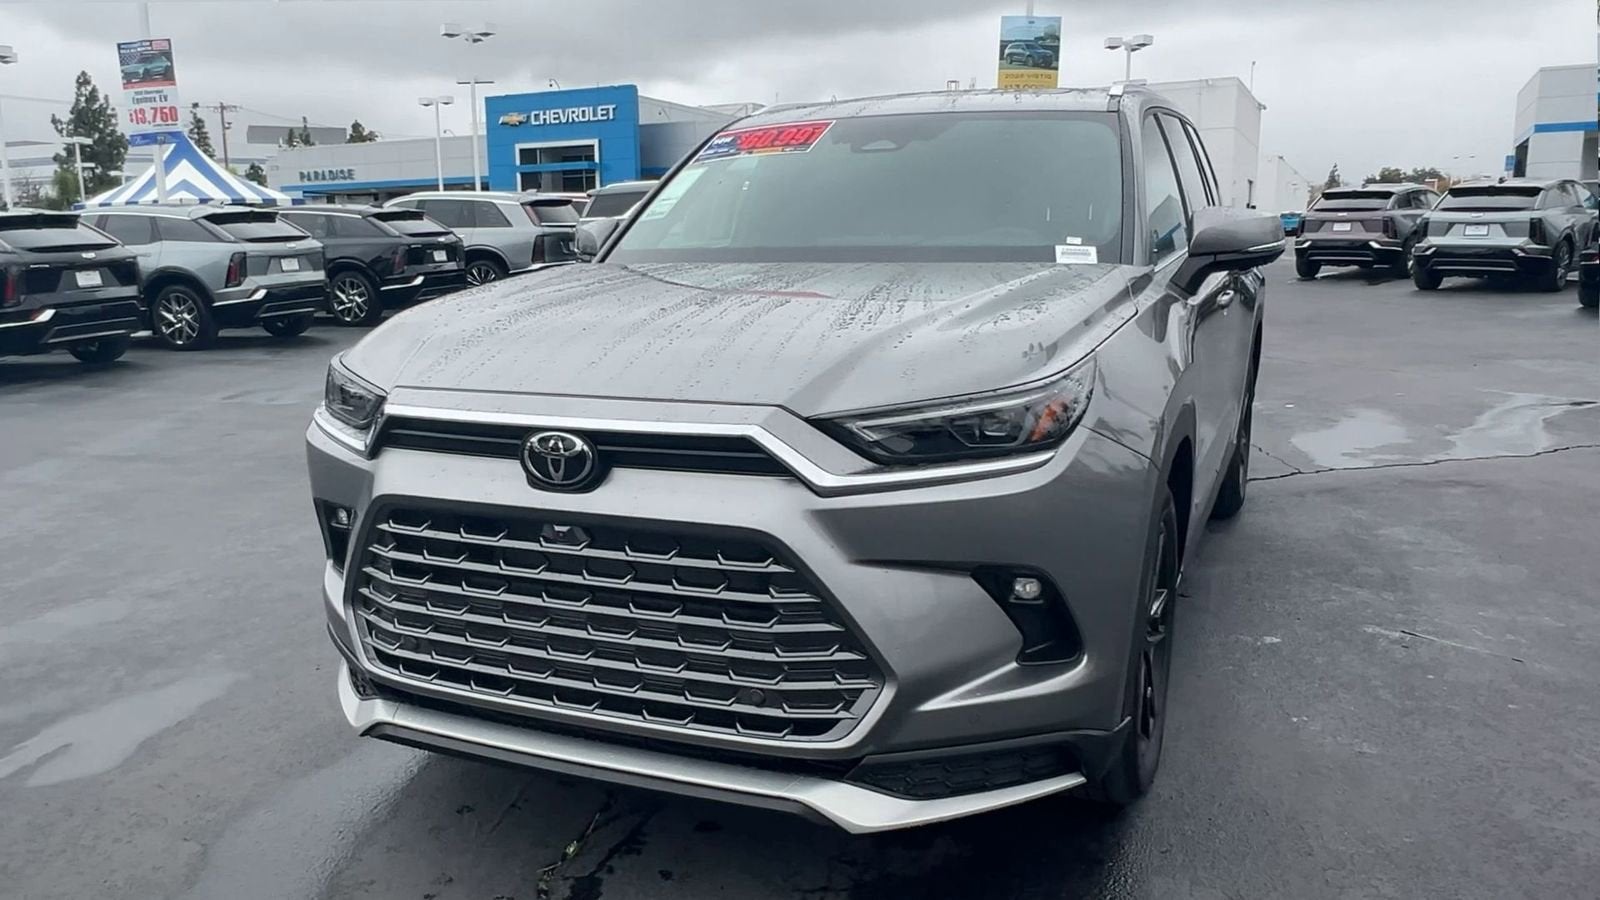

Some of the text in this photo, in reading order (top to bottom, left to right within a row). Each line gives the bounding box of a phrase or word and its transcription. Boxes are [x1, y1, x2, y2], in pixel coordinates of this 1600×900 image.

[158, 94, 168, 102] EV
[531, 104, 617, 126] CHEVROLET
[299, 168, 356, 182] PARADISE
